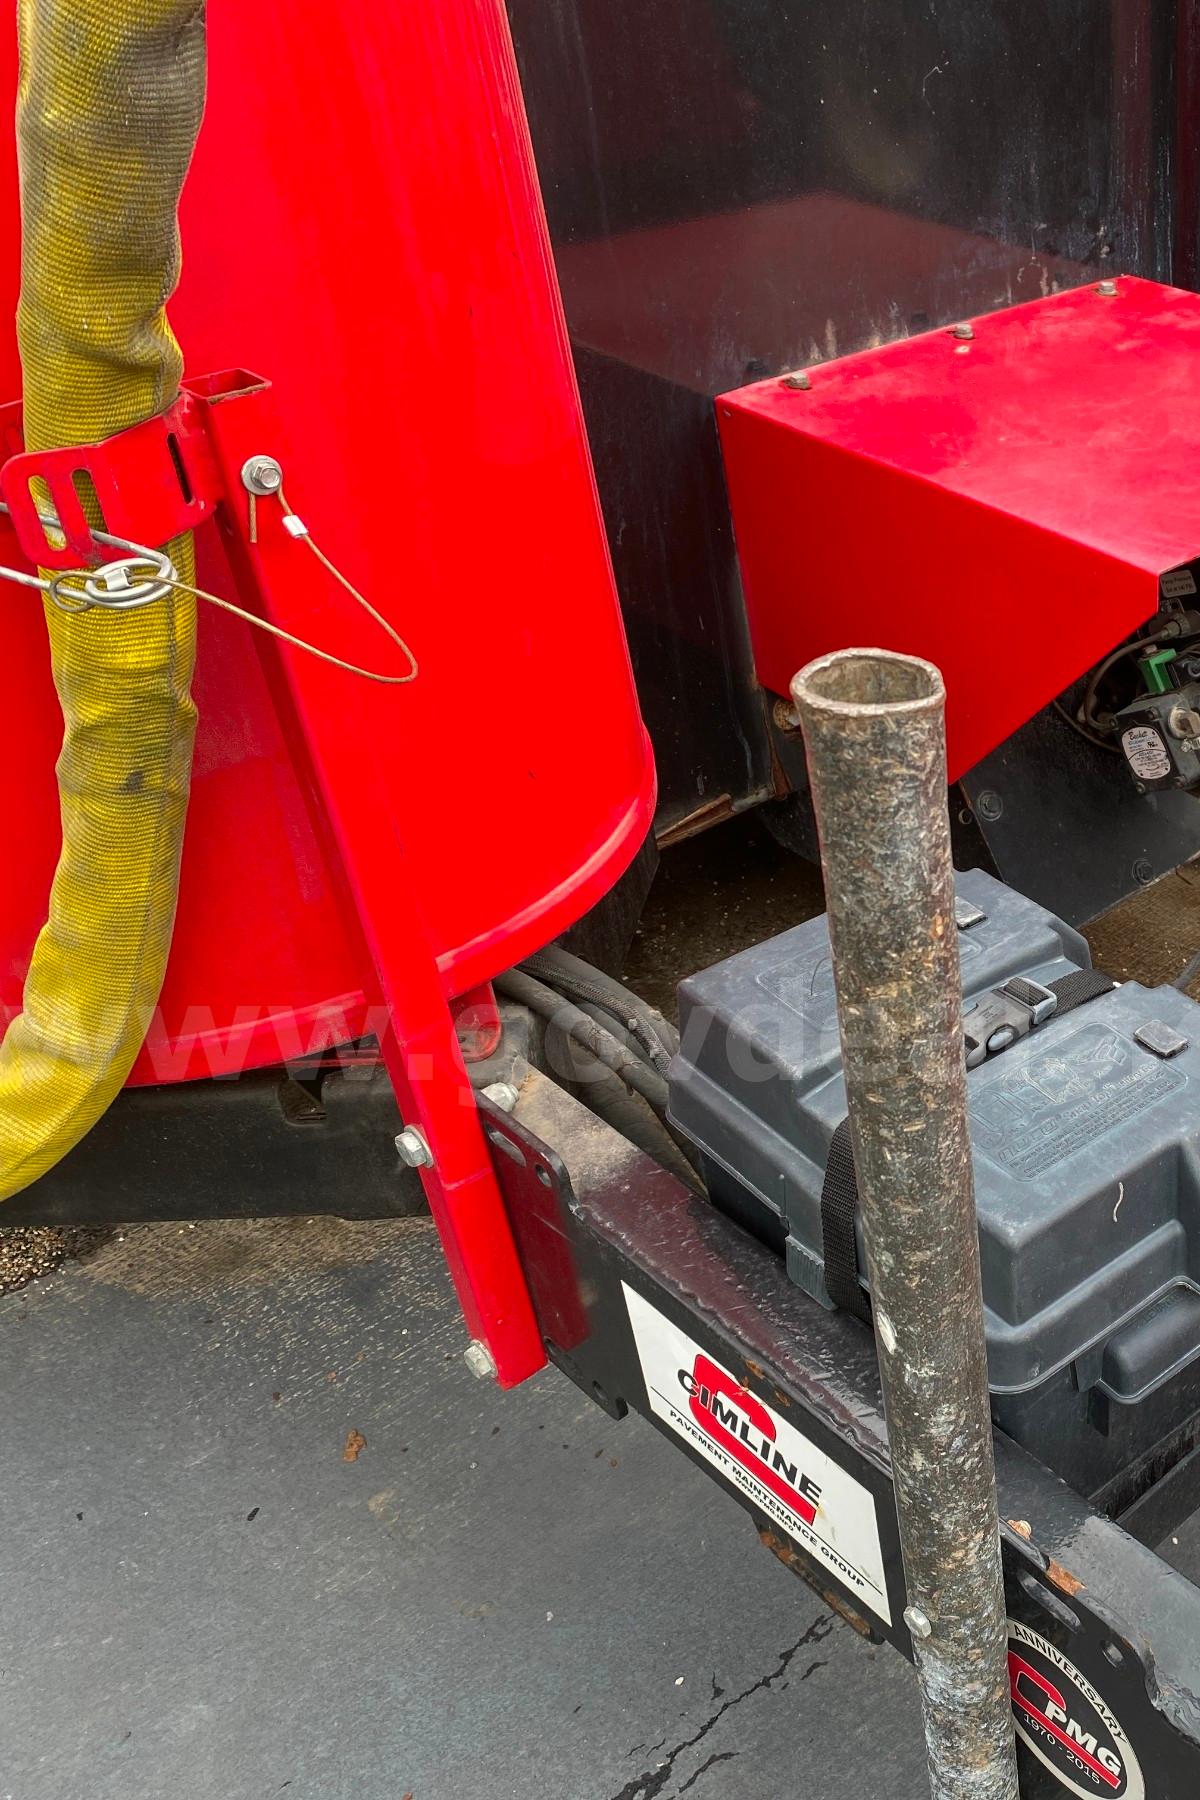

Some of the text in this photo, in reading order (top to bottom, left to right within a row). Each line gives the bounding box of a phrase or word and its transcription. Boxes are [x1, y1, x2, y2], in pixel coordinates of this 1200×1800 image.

[670, 1409, 865, 1587] PAVEMENT MAINTENANCE GROUP
[677, 1368, 822, 1507] CIMLINE
[1014, 1624, 1128, 1743] ANNIVERSARY
[1023, 1713, 1056, 1745] 1970
[1066, 1753, 1100, 1785] 2015
